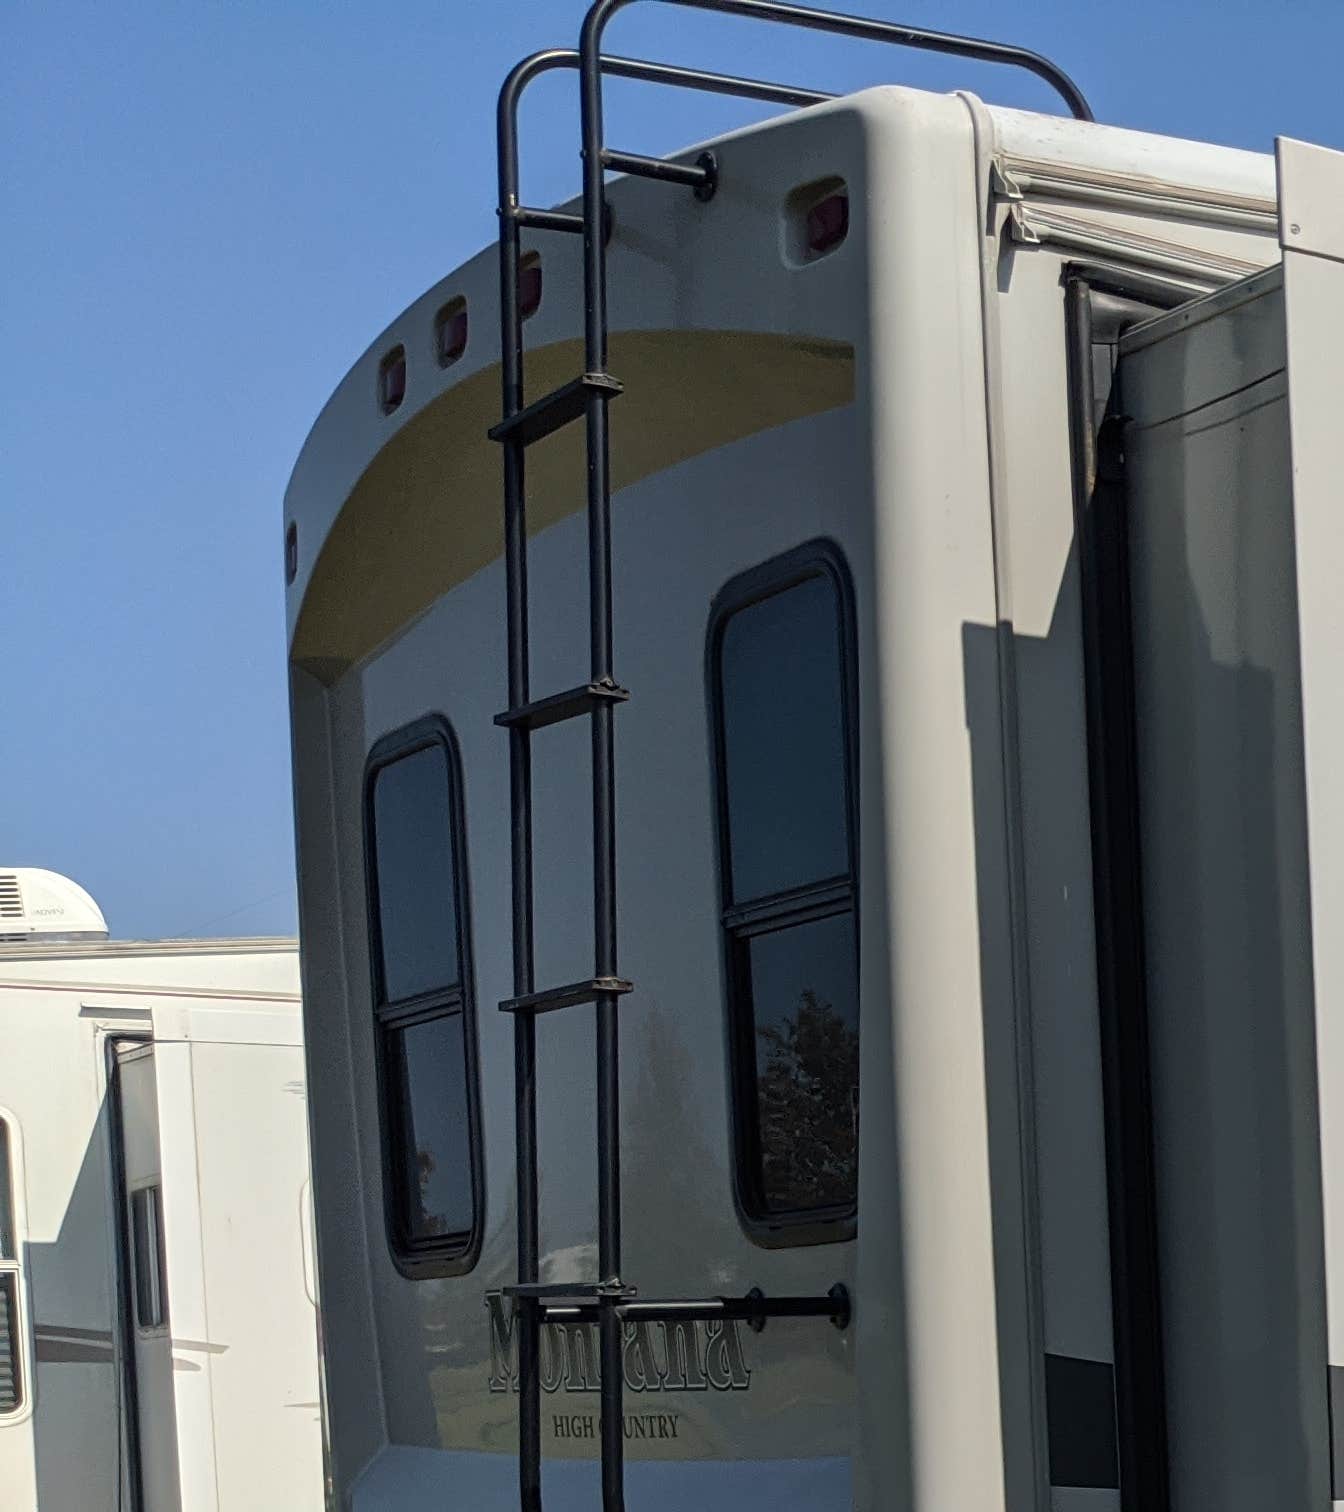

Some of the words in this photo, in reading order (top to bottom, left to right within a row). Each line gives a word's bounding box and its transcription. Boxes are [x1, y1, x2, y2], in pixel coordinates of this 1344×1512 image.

[485, 1290, 751, 1393] Monana
[552, 1415, 595, 1438] HIGH
[599, 1415, 679, 1439] UNTRY
